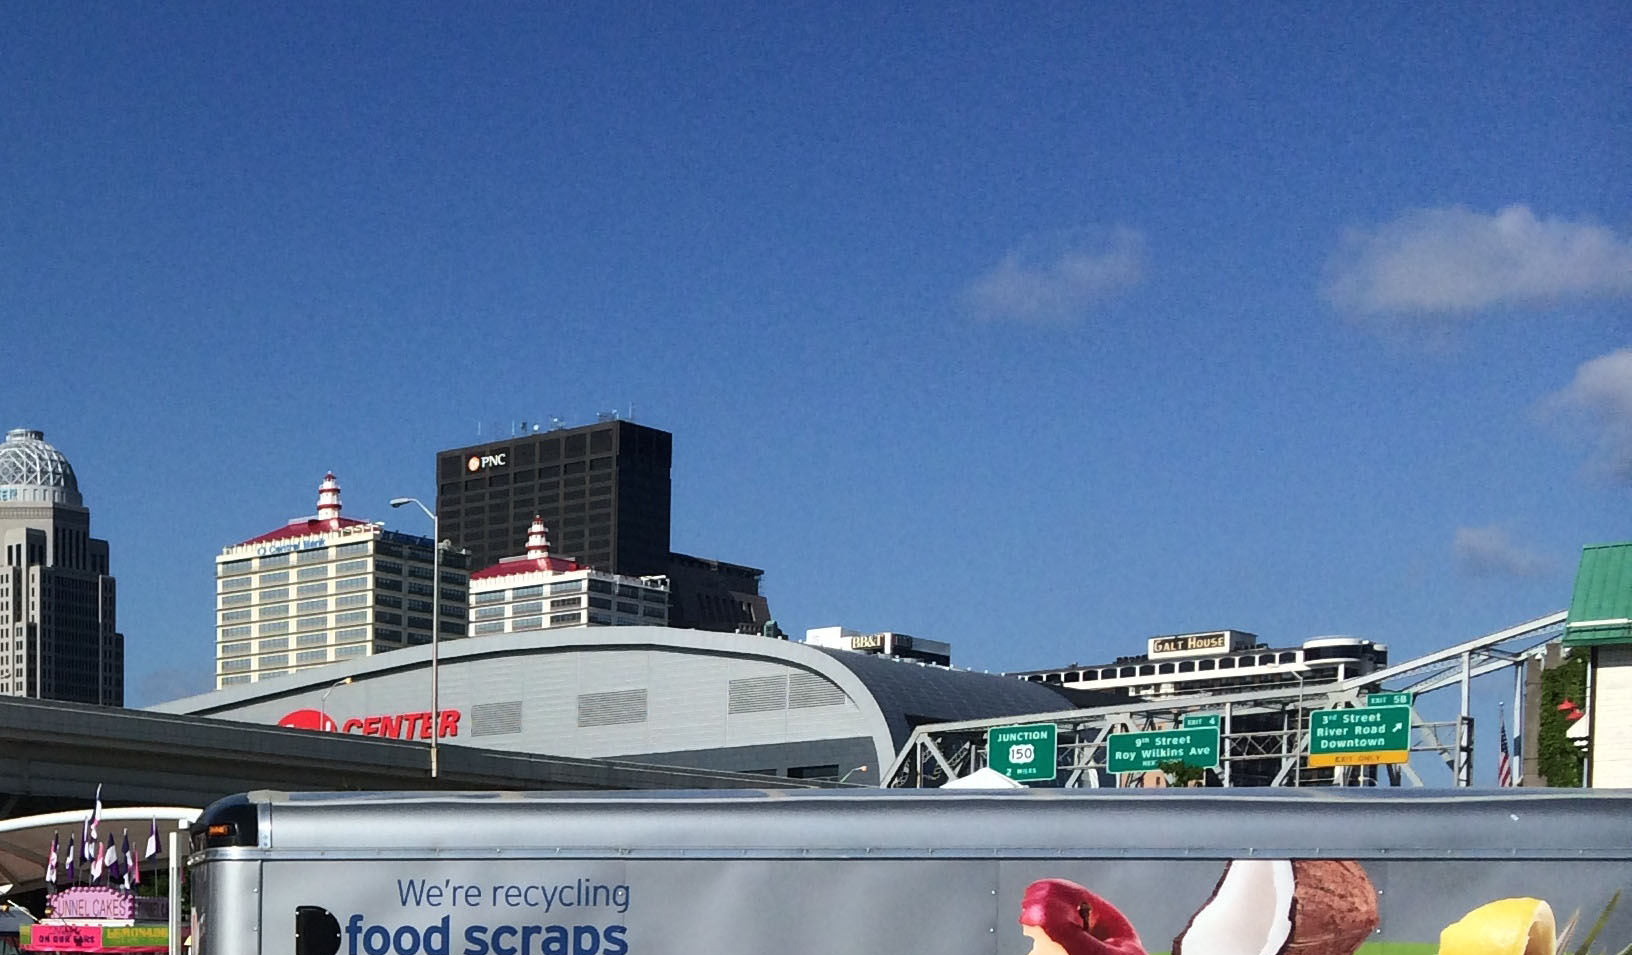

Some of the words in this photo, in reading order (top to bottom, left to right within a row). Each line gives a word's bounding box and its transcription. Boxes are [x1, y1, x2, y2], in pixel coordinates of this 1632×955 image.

[480, 453, 506, 468] PNC
[852, 634, 882, 649] BB&T
[1371, 696, 1387, 704] EXIT
[1393, 694, 1408, 704] 5B
[342, 707, 461, 741] CENTER
[1209, 717, 1216, 725] 4
[1342, 713, 1382, 724] Street
[997, 731, 1048, 743] JUNCTION
[1316, 727, 1349, 737] River
[1354, 724, 1386, 735] Road
[1155, 735, 1191, 746] Street
[1320, 738, 1385, 749] Downtown
[1011, 747, 1032, 760] 150
[1115, 751, 1136, 761] Roy
[1141, 748, 1184, 759] Wilkins
[1189, 746, 1210, 756] Ave
[1005, 768, 1012, 777] 2
[397, 879, 481, 907] We're
[493, 878, 630, 913] recycling
[92, 898, 127, 917] CAKES
